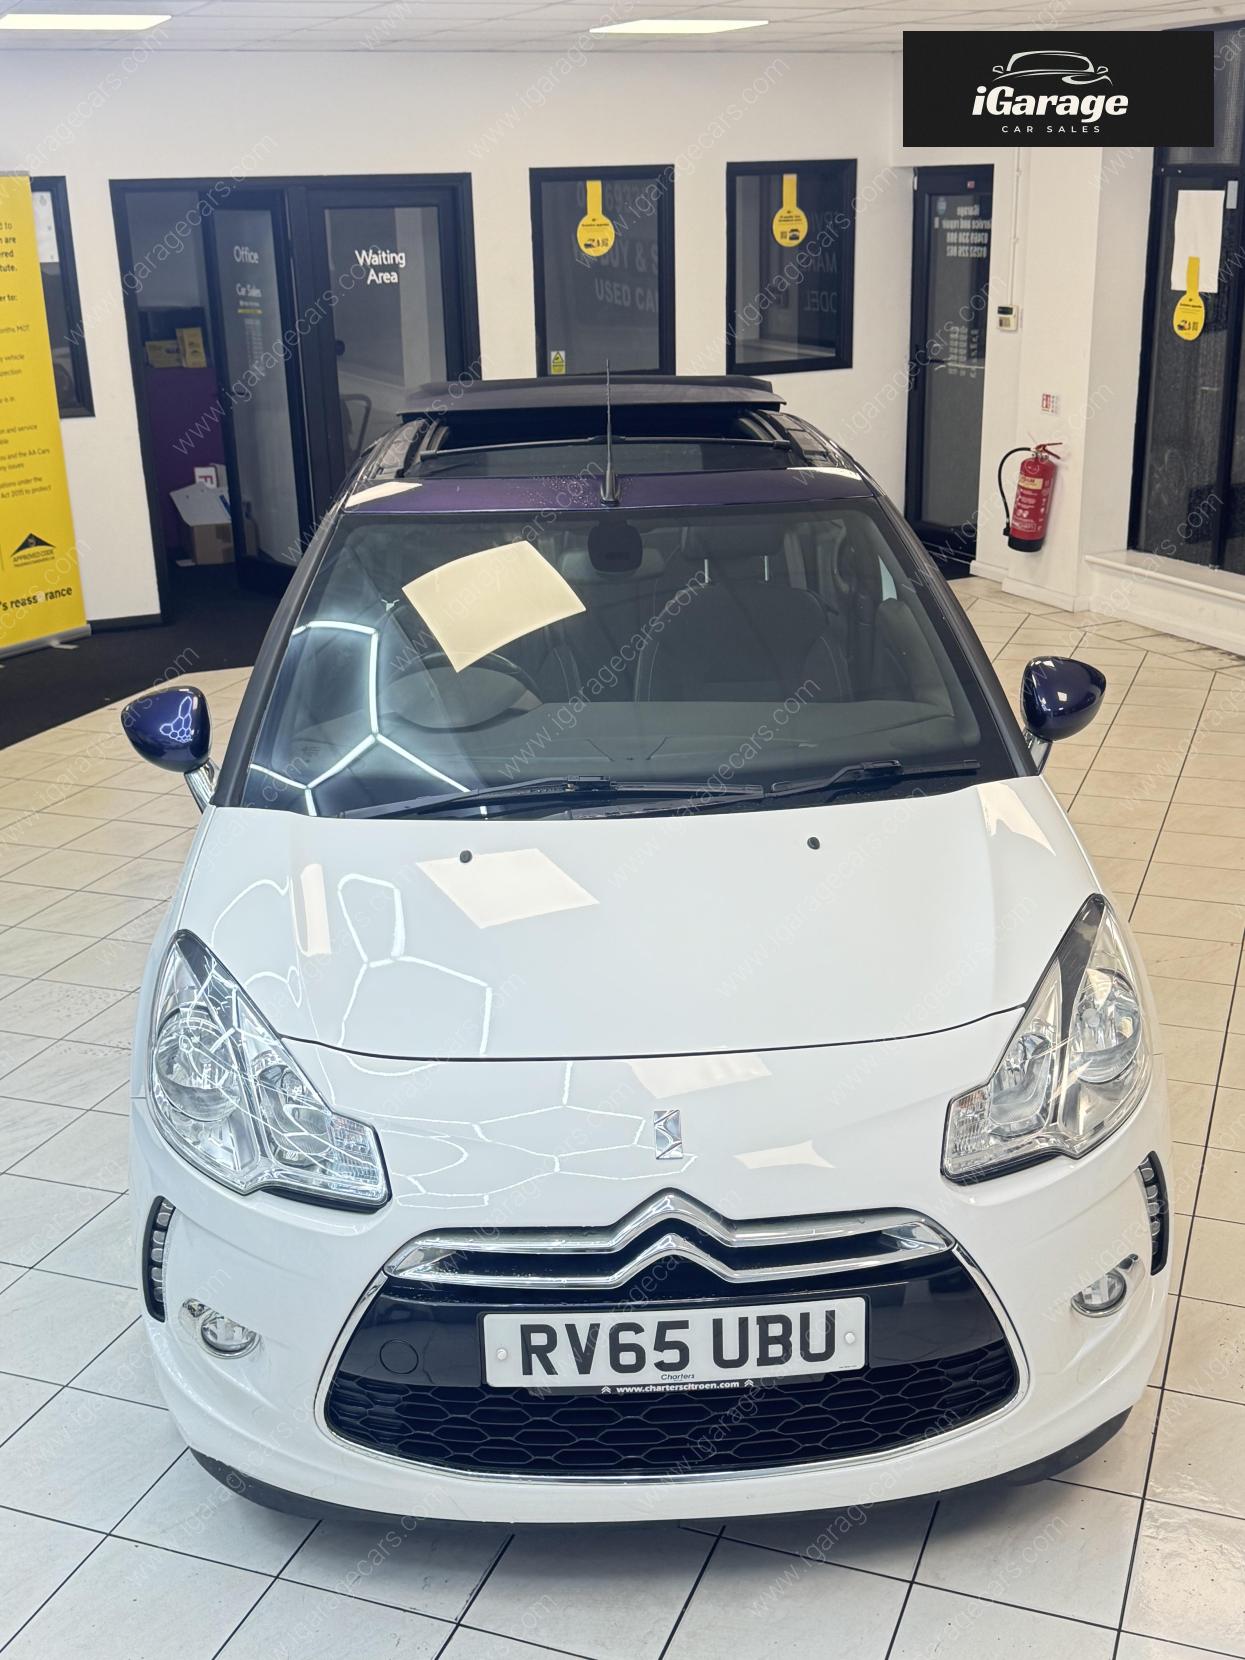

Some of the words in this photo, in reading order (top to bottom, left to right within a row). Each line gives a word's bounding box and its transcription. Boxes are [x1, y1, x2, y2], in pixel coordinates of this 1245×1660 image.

[233, 246, 259, 264] Office
[355, 249, 406, 268] Waiting
[367, 268, 398, 285] Area
[595, 277, 631, 307] USED
[10, 586, 73, 609] reassrance
[520, 1319, 691, 1376] RV65
[712, 1310, 836, 1369] UBU
[660, 1372, 695, 1382] Charters
[616, 1380, 739, 1395] www.charterscitroen.com
